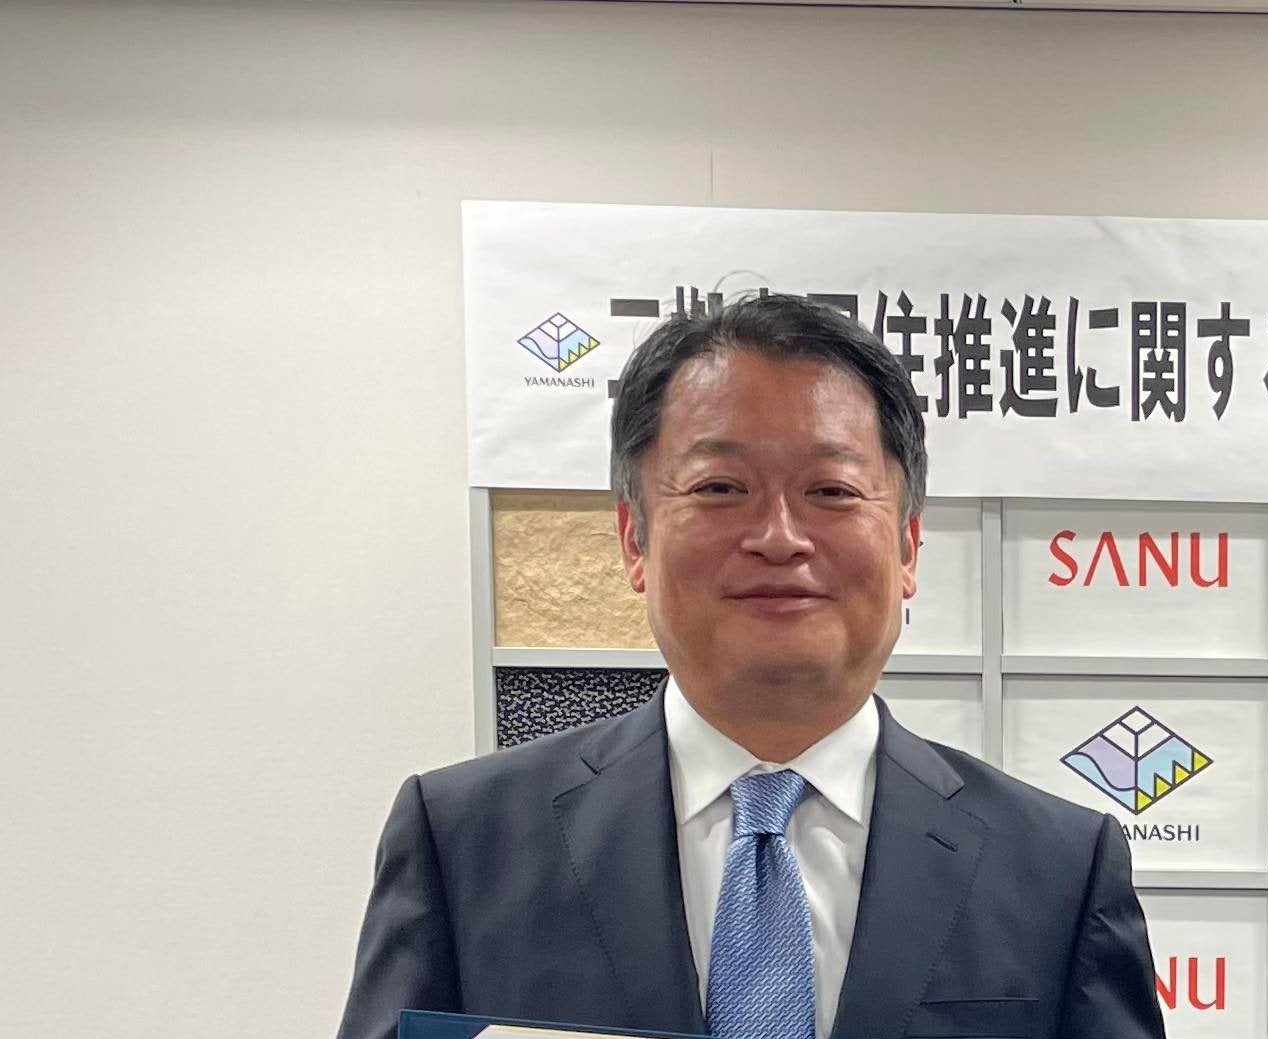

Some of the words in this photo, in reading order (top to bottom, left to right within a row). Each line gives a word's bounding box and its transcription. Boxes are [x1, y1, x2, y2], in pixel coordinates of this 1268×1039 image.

[524, 376, 595, 388] YAMANASHI
[1048, 530, 1230, 588] SANU
[1122, 824, 1200, 841] ANASHI
[1154, 956, 1225, 1010] NU
